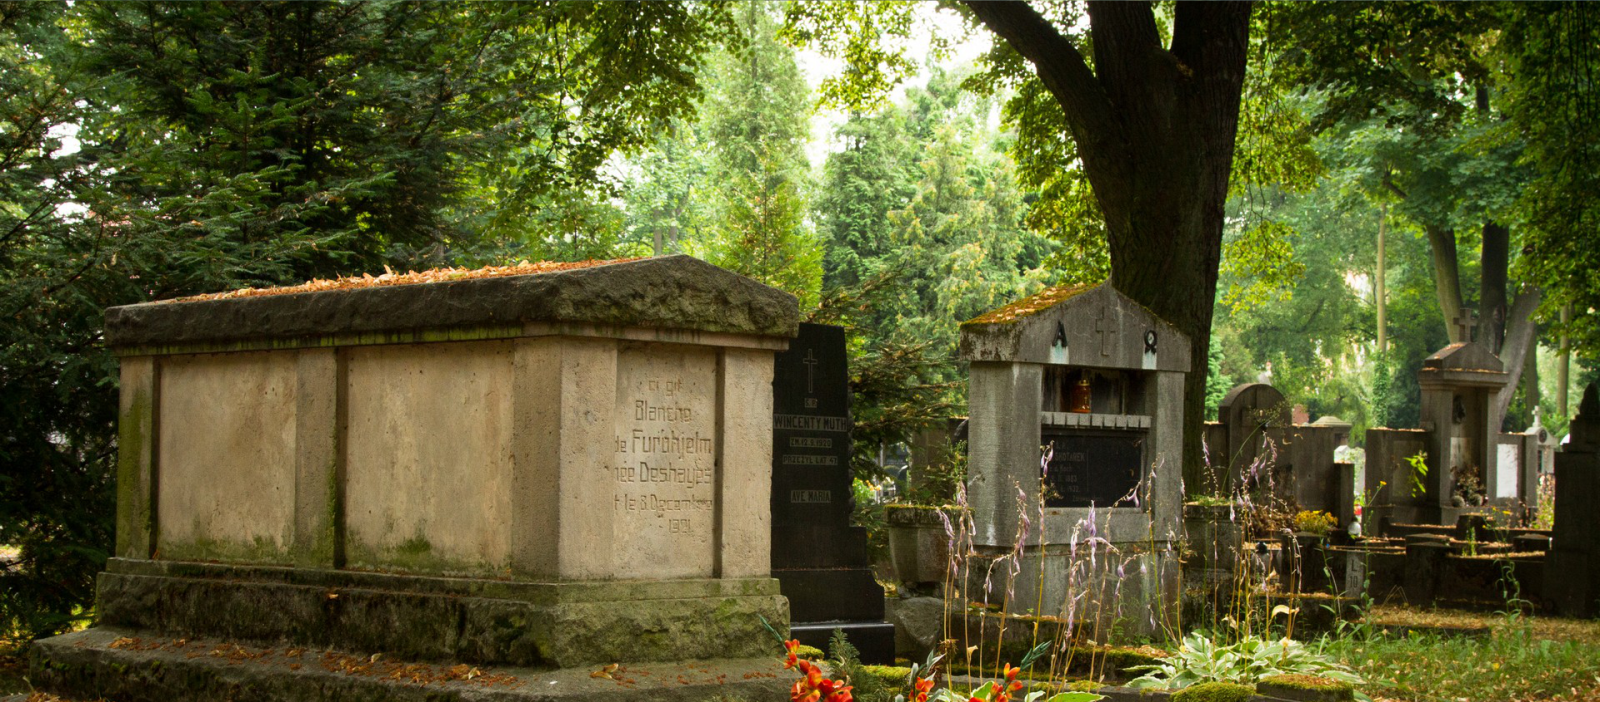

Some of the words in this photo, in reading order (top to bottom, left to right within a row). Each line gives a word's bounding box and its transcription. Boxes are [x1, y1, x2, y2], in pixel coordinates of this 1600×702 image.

[635, 399, 692, 422] Blanche
[774, 415, 822, 429] WINCENTY
[823, 417, 847, 431] MUTH
[815, 456, 827, 464] LAT
[624, 493, 636, 511] le
[791, 490, 806, 502] AVE
[808, 490, 830, 502] MARIA
[1351, 559, 1358, 572] L
